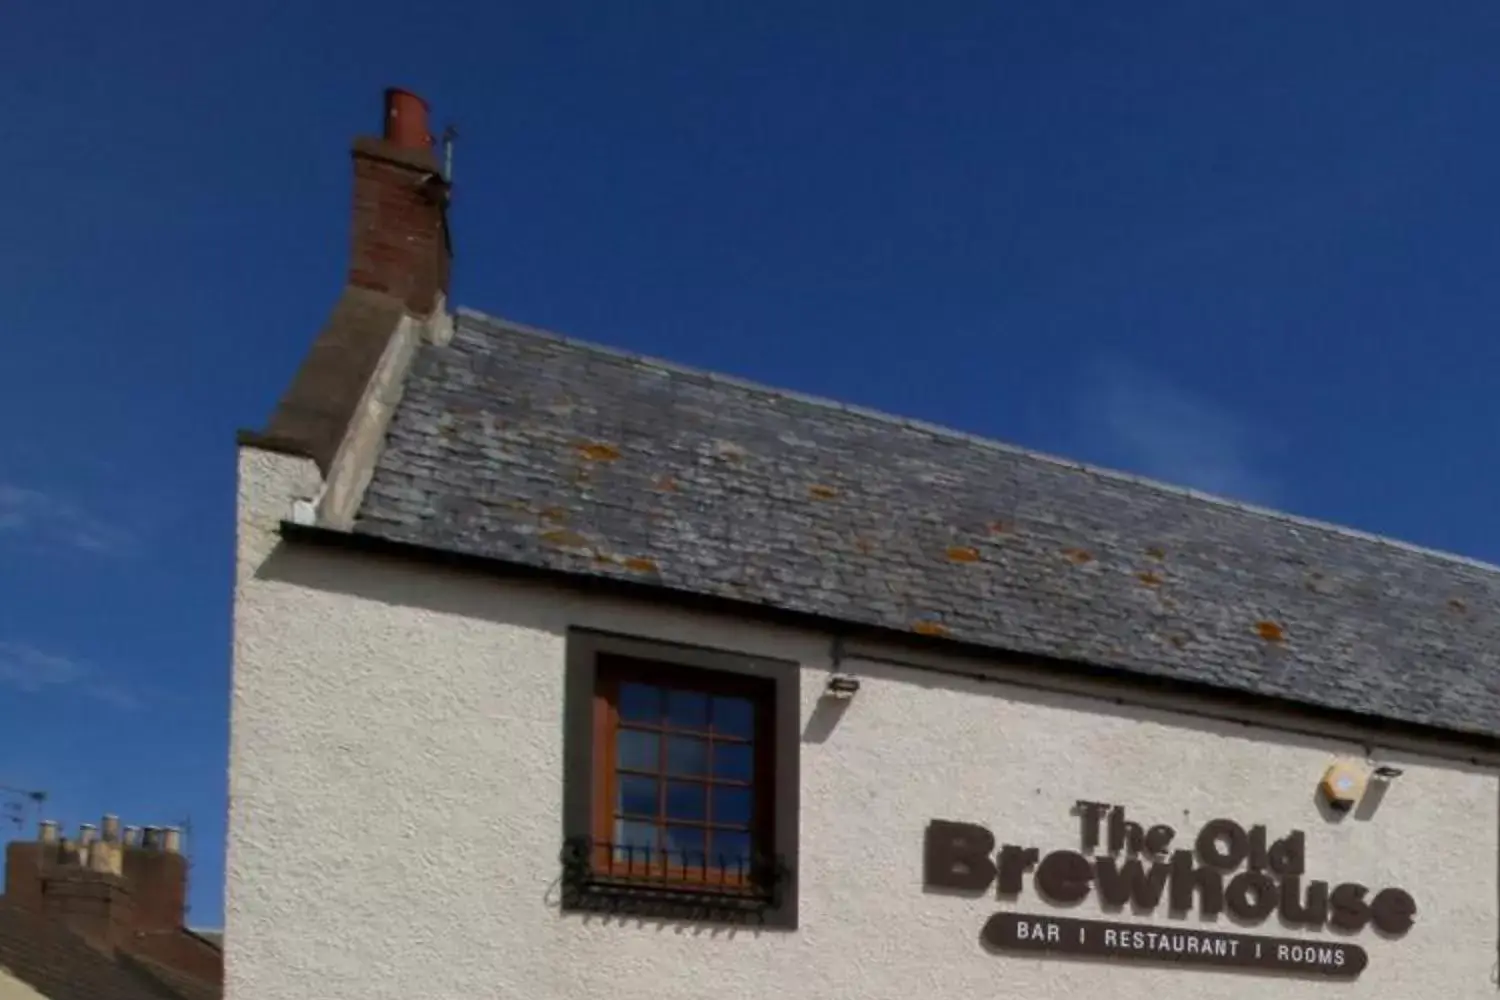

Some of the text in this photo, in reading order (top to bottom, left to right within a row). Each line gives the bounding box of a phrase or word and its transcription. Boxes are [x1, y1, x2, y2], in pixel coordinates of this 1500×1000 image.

[1075, 800, 1304, 876] The Old
[922, 820, 1417, 938] Brewhouse
[1017, 921, 1061, 942] BAR
[1105, 930, 1240, 957] RESTAURANT
[1277, 945, 1346, 966] ROOMS
